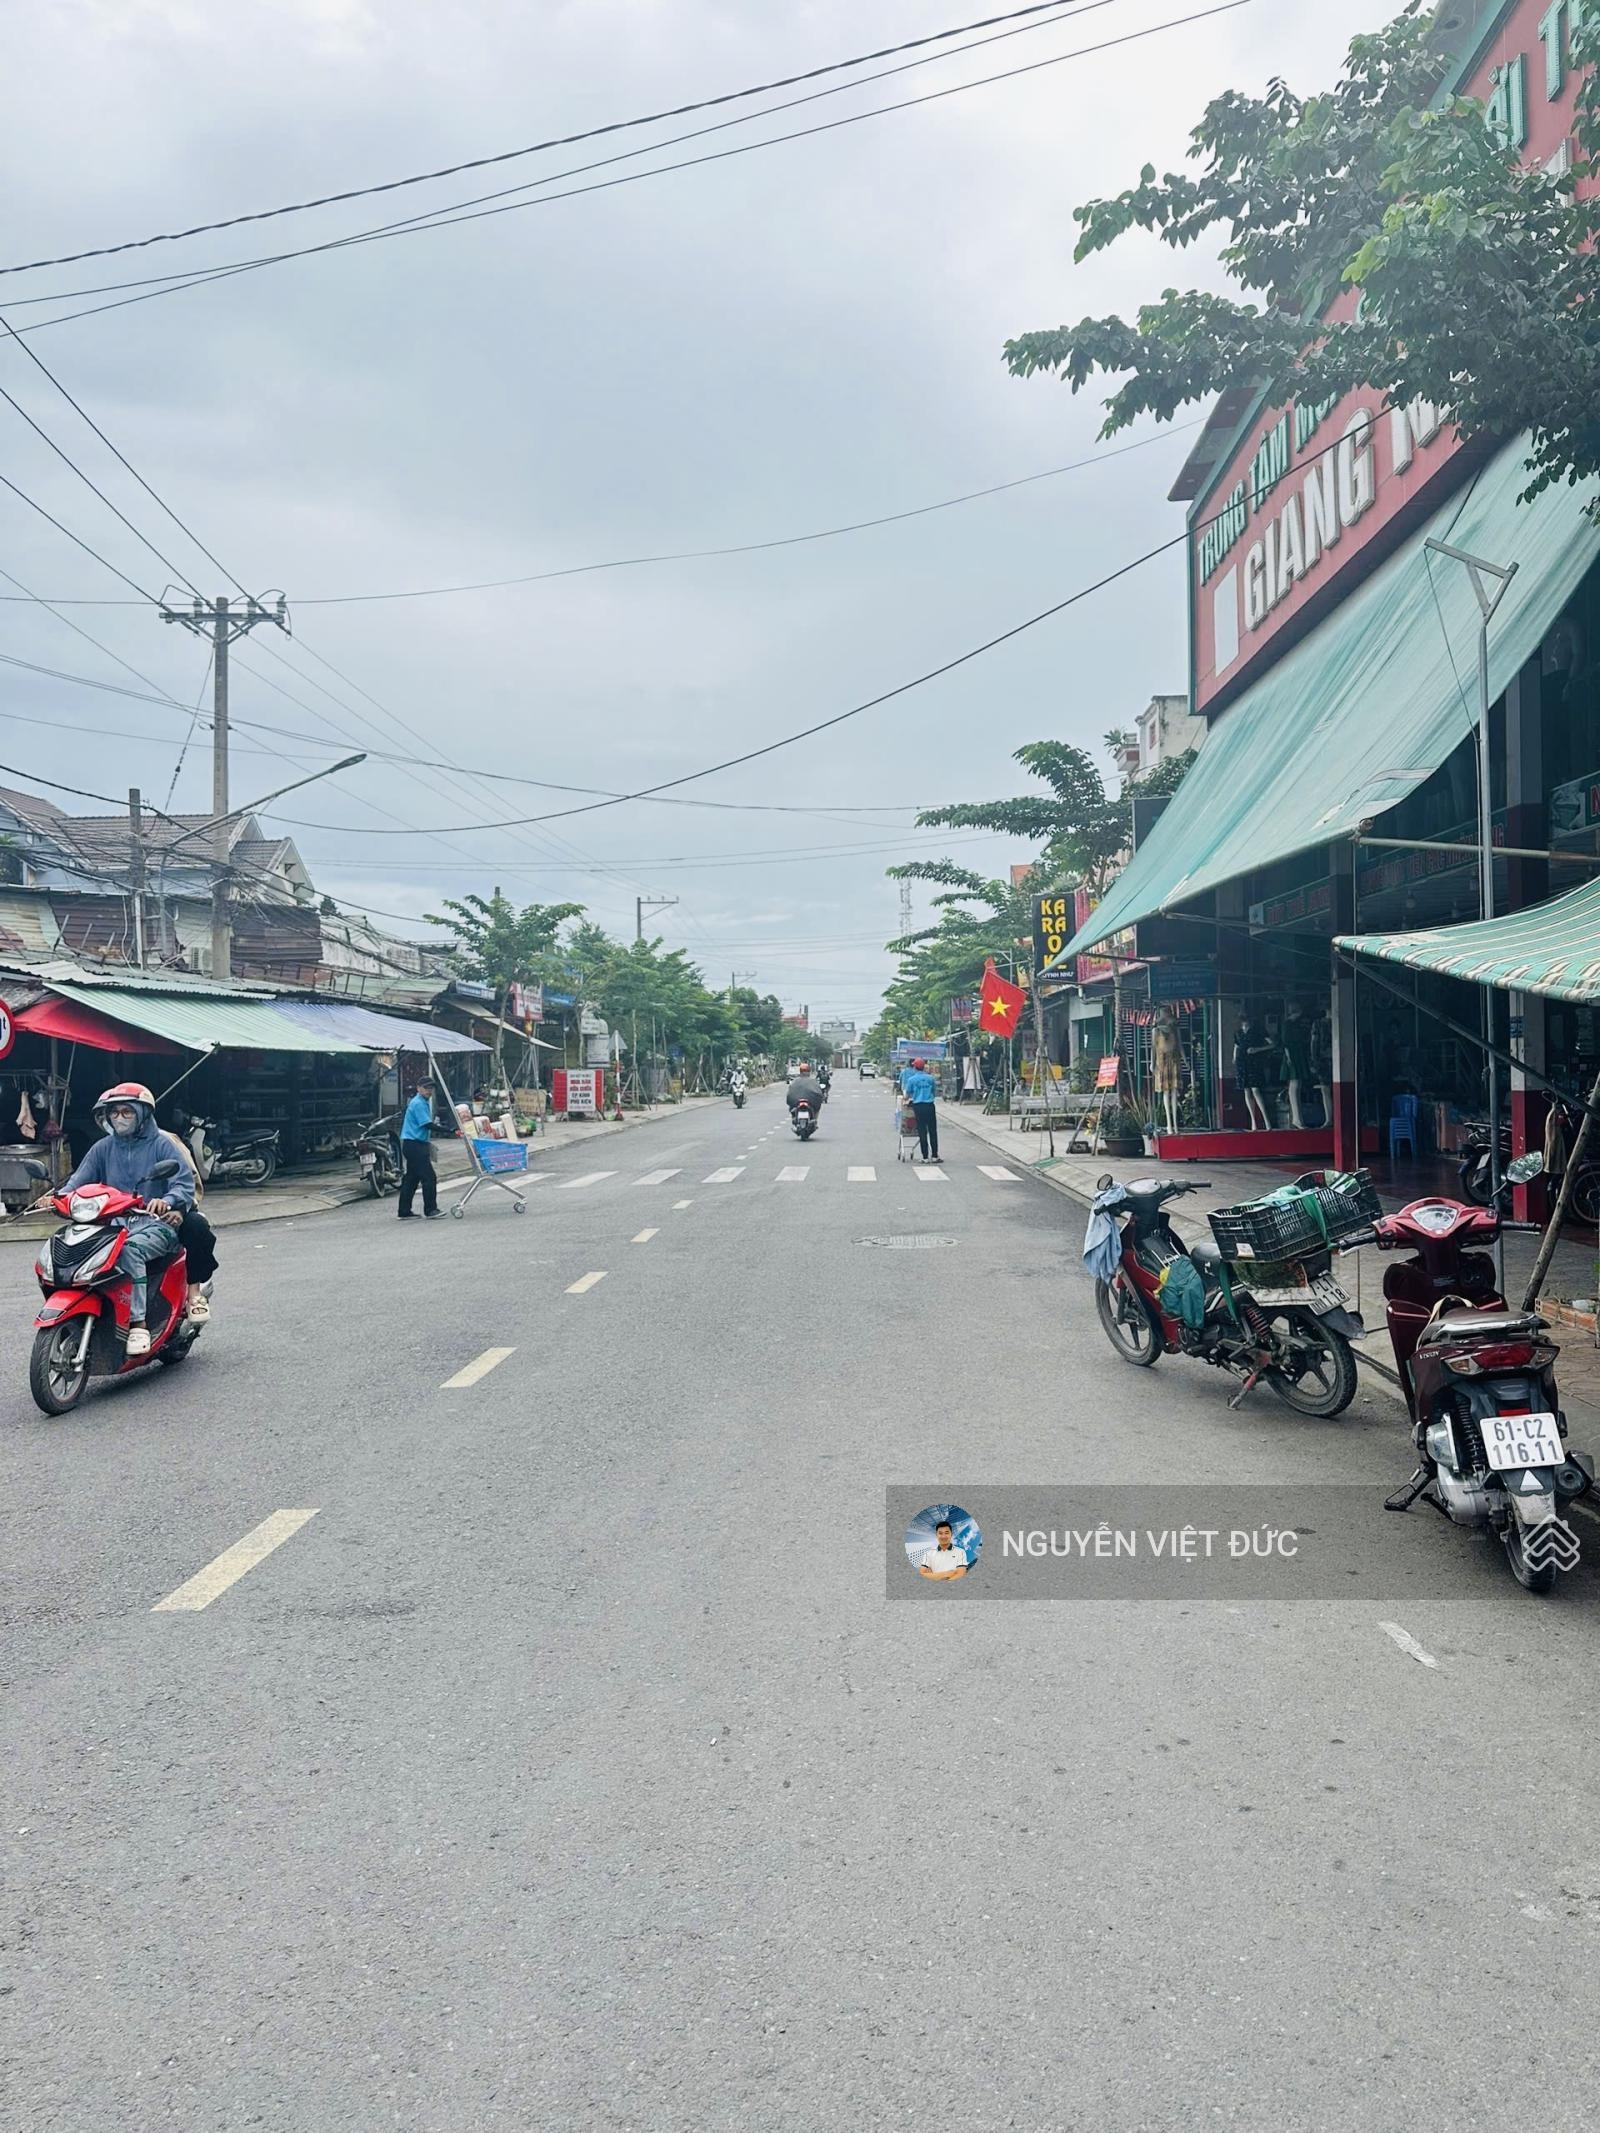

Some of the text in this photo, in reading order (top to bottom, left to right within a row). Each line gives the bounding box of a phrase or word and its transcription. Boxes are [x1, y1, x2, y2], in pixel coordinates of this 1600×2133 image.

[1198, 410, 1290, 586] TRUNG TÂM
[1244, 407, 1375, 631] GIANG
[1493, 1440, 1558, 1464] 116.11
[1494, 1418, 1546, 1441] 61-C2
